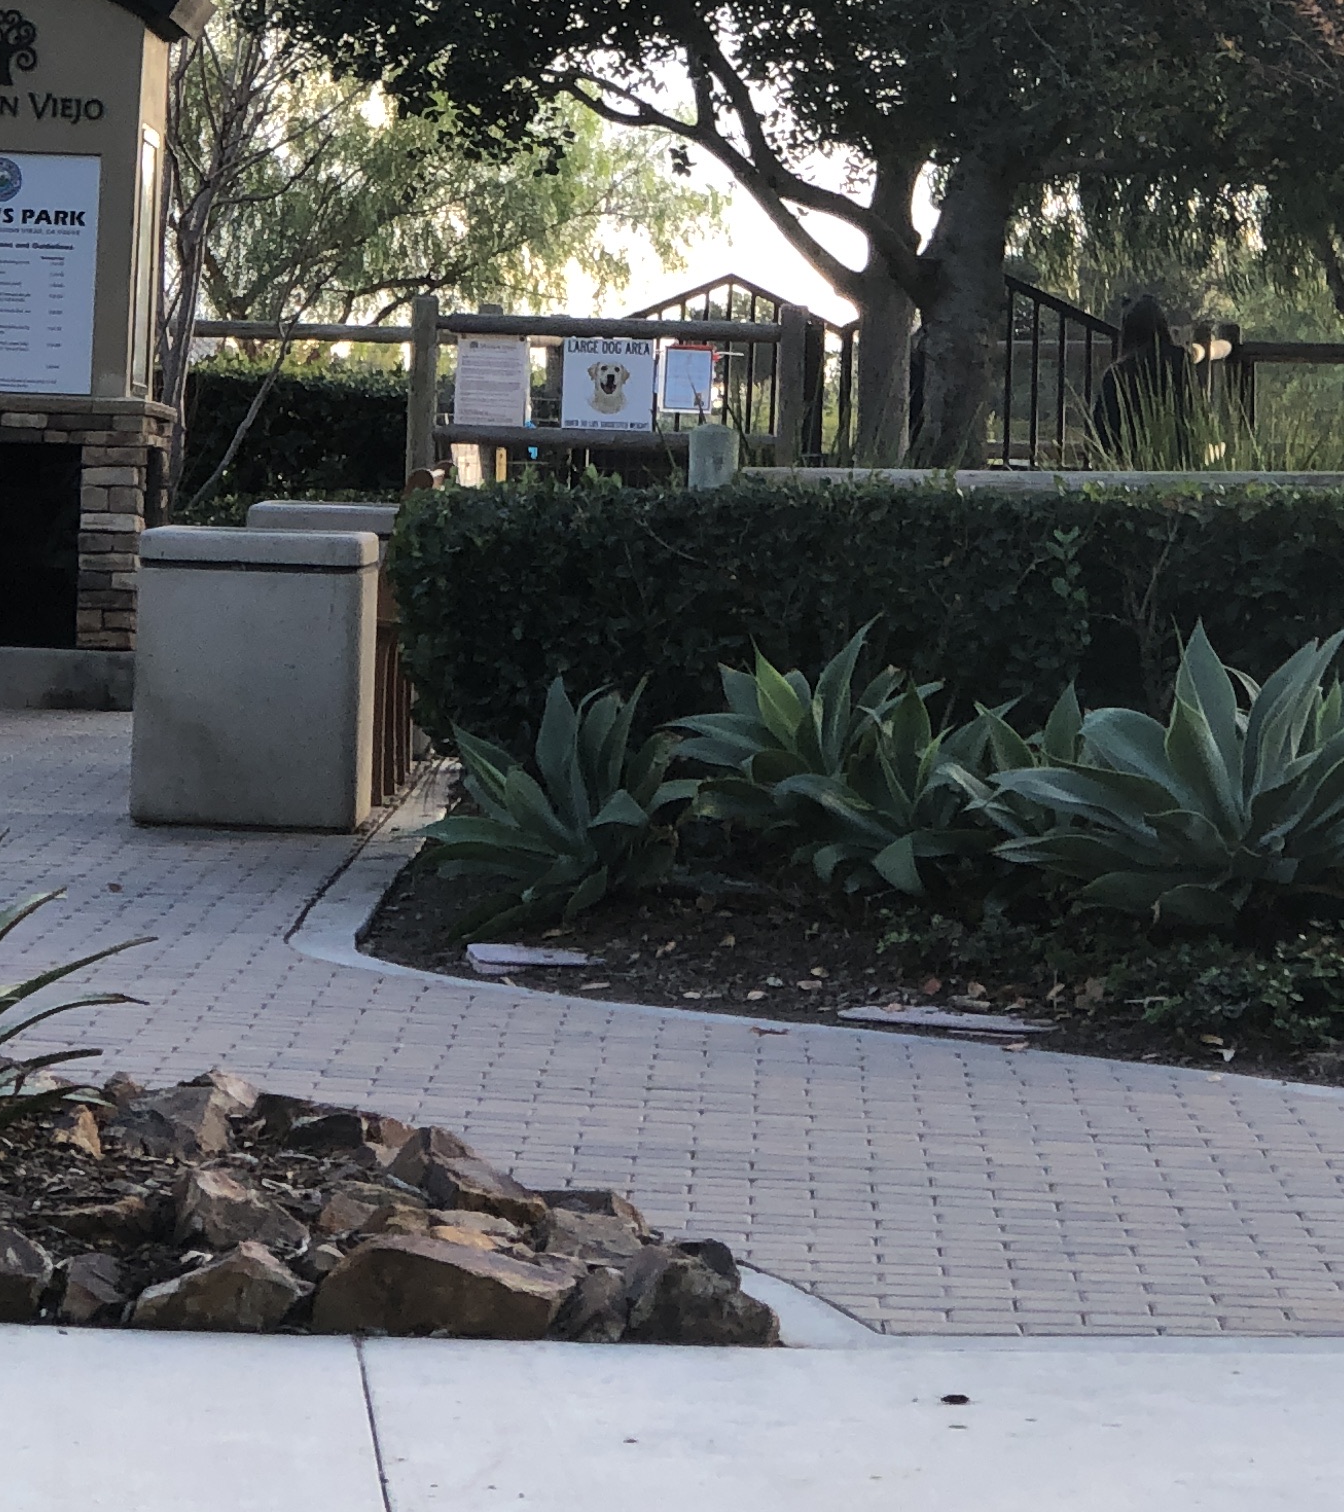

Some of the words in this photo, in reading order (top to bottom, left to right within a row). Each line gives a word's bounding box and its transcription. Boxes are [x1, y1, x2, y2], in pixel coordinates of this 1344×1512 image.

[27, 92, 105, 125] VIEJO
[21, 208, 86, 227] PARK
[567, 340, 599, 354] LARGE
[602, 341, 622, 355] DOG
[625, 342, 650, 356] AREA
